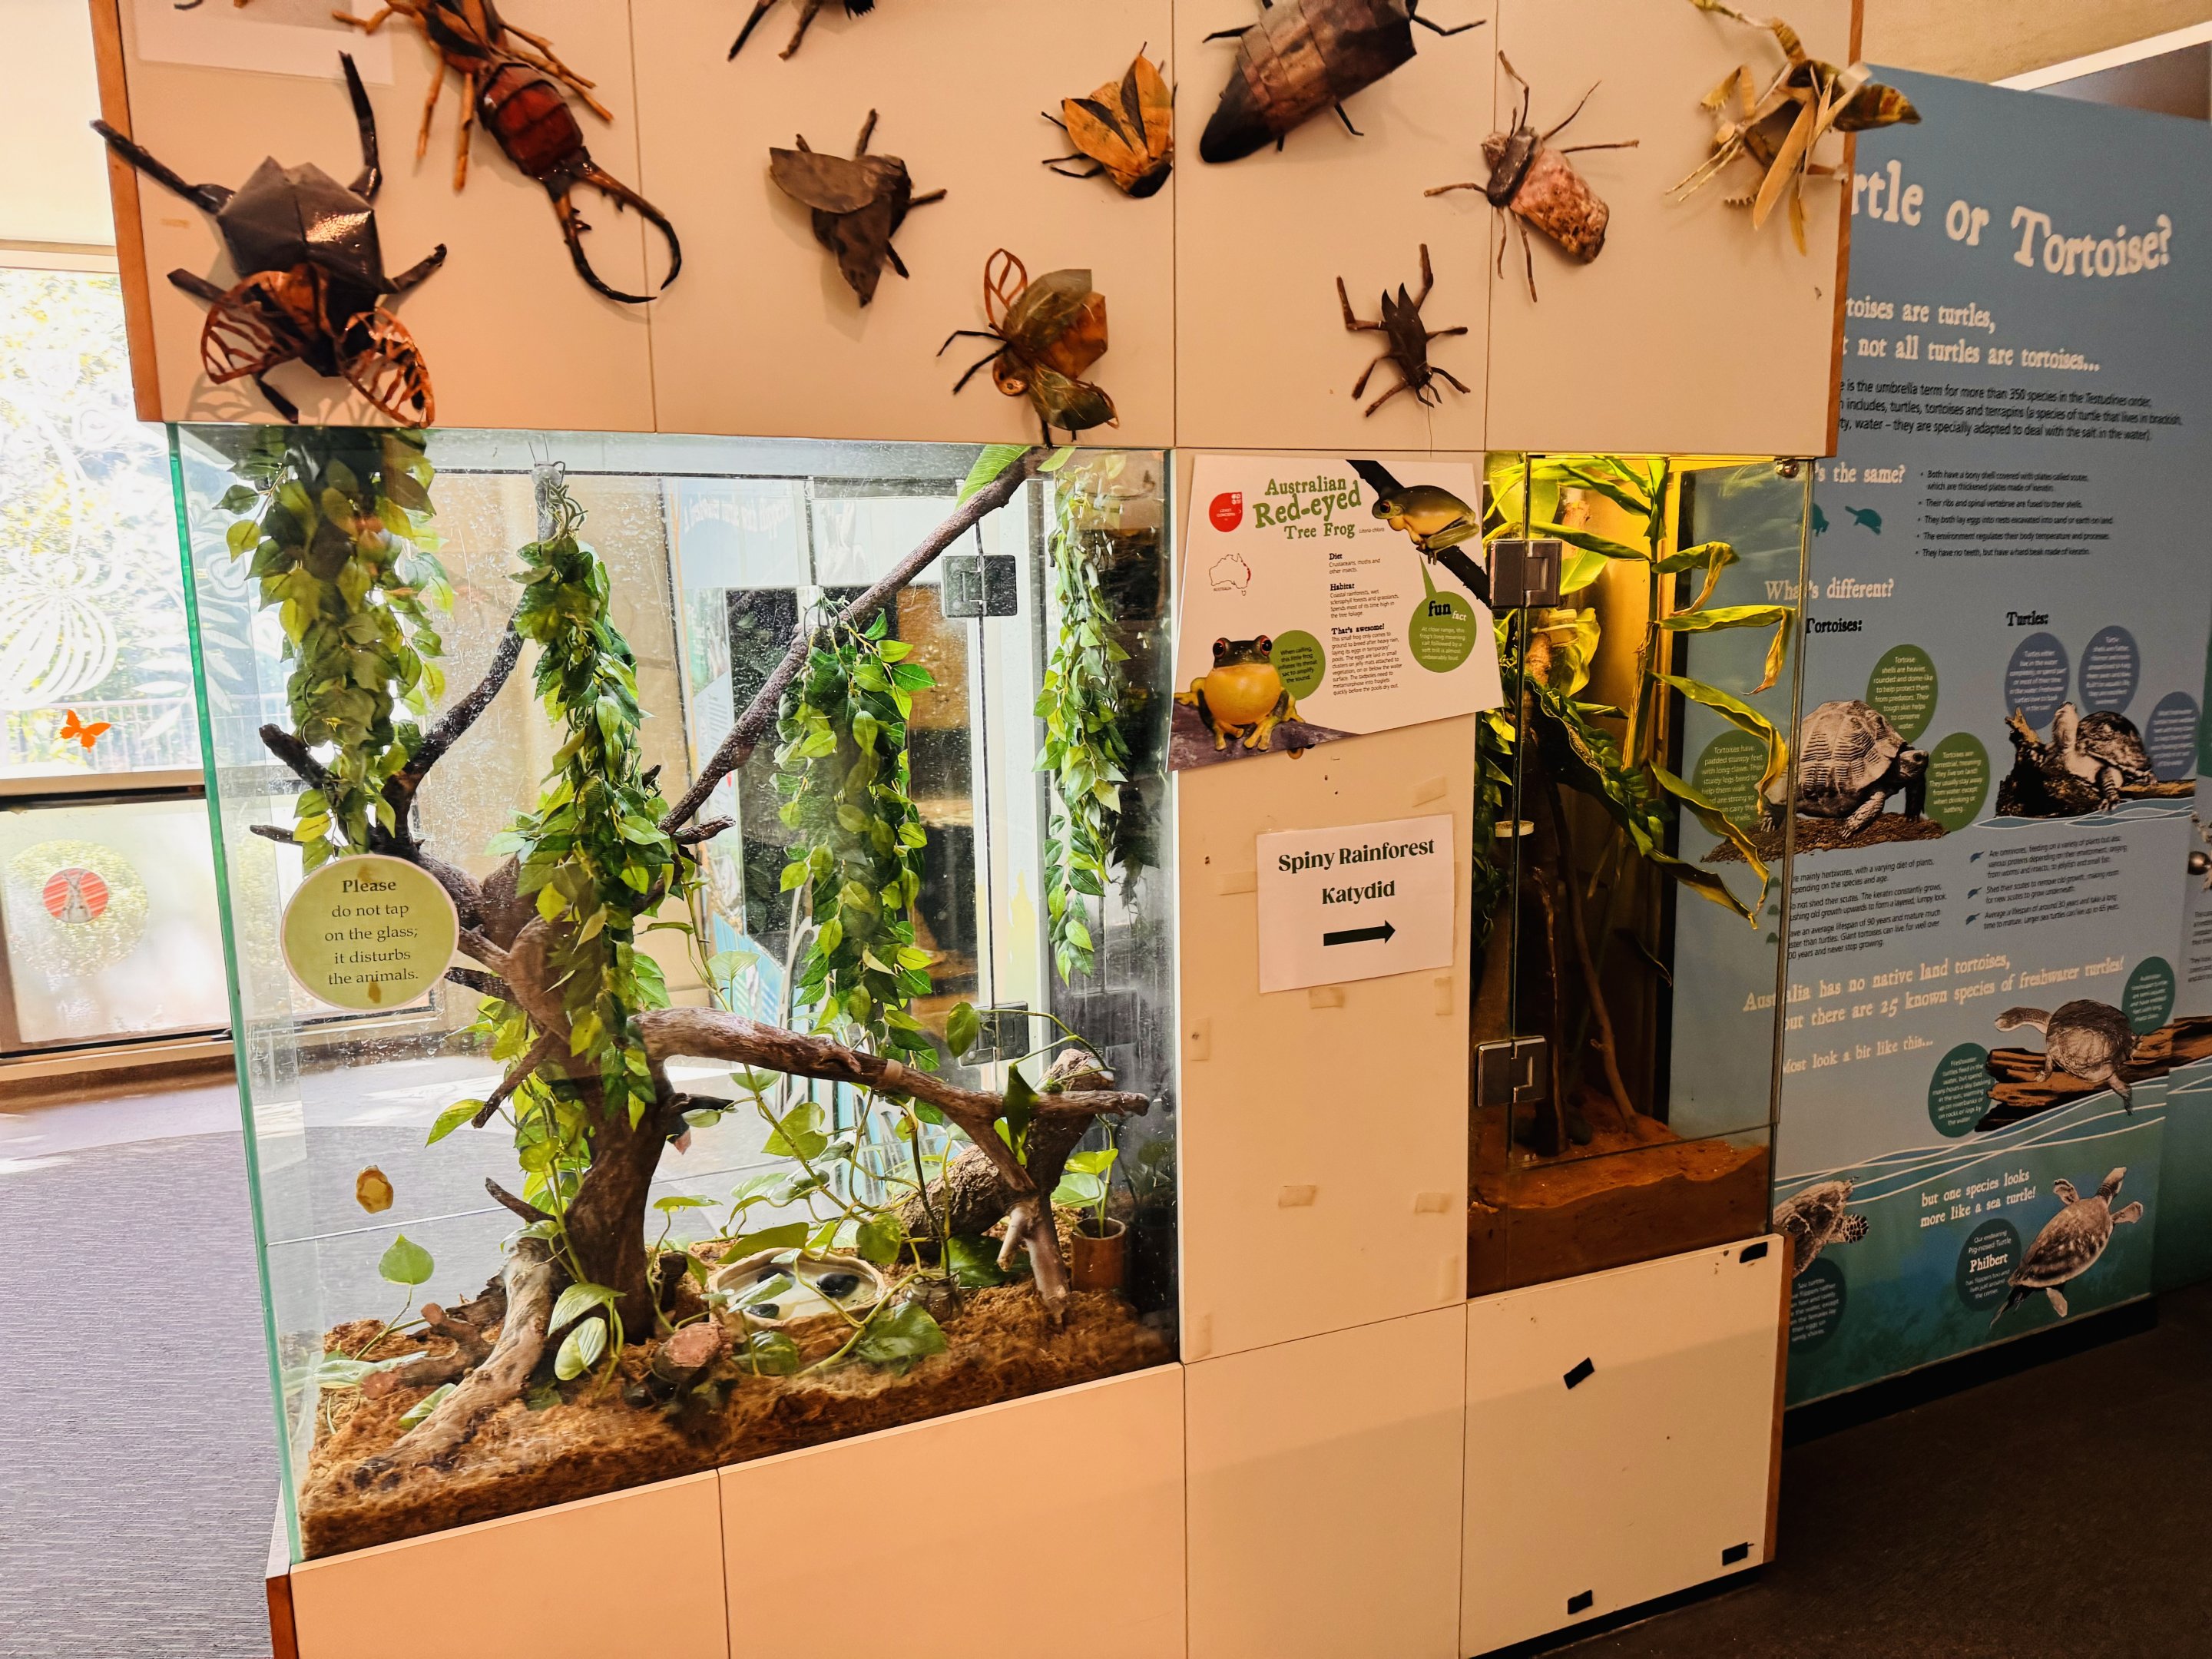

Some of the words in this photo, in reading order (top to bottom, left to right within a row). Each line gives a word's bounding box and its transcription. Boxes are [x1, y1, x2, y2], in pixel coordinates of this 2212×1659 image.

[1945, 200, 1989, 246] or
[2010, 206, 2172, 276] Tortoise?
[1902, 303, 1929, 323] are
[1938, 303, 1995, 334] turtles,
[1857, 338, 1887, 357] not
[1895, 336, 1919, 359] all
[1928, 339, 1980, 363] turtles
[1988, 348, 2014, 366] are
[1833, 462, 1856, 483] the
[1863, 464, 1906, 483] same?
[1264, 475, 1346, 495] Australian
[1252, 479, 1362, 528] Red-eyed
[1283, 525, 1316, 539] Tree
[1323, 522, 1355, 539] Frog
[1330, 582, 1355, 591] Habitat
[1826, 577, 1894, 598] different?
[1428, 601, 1452, 617] fun
[1452, 611, 1467, 621] fact
[2006, 610, 2049, 627] Turtles:
[1331, 627, 1353, 635] That's
[1356, 623, 1385, 632] awesome!
[1805, 618, 1863, 635] Tortoises:
[1278, 851, 1335, 874] Spiny
[1339, 839, 1434, 865] Rainforest
[343, 879, 396, 893] Please
[1322, 880, 1395, 905] Katydid
[332, 905, 351, 917] do
[356, 905, 380, 916] not
[386, 904, 409, 918] tap
[325, 932, 344, 941] on
[349, 927, 373, 940] the
[377, 926, 418, 942] glass;
[335, 952, 344, 964] it
[349, 949, 411, 963] disturbs
[329, 972, 352, 985] the
[356, 968, 419, 984] animals.
[1819, 979, 1841, 998] has
[1848, 979, 1866, 992] no
[1872, 970, 1913, 988] native
[1919, 959, 1949, 981] land
[1955, 955, 2011, 974] tortoises,
[1811, 1007, 1846, 1026] there
[1852, 1003, 1873, 1018] are
[1880, 997, 1899, 1018] 25
[1905, 990, 1948, 1009] known
[1954, 980, 1995, 1005] species
[2001, 973, 2016, 992] of
[2018, 967, 2080, 988] freshwater
[1812, 1050, 1838, 1068] look
[1843, 1051, 1851, 1062] a
[1856, 1045, 1872, 1060] bit
[1876, 1039, 1898, 1056] like
[1903, 1035, 1933, 1051] this...
[1922, 1192, 1939, 1207] but
[1943, 1188, 1962, 1201] one
[1965, 1178, 1999, 1198] species
[2003, 1169, 2029, 1187] looks
[1920, 1212, 1945, 1227] more
[1950, 1204, 1971, 1220] like
[1975, 1203, 1982, 1214] a
[1986, 1198, 2002, 1210] sea
[2006, 1186, 2036, 1205] turtle!
[1969, 1253, 2008, 1273] Philbert
